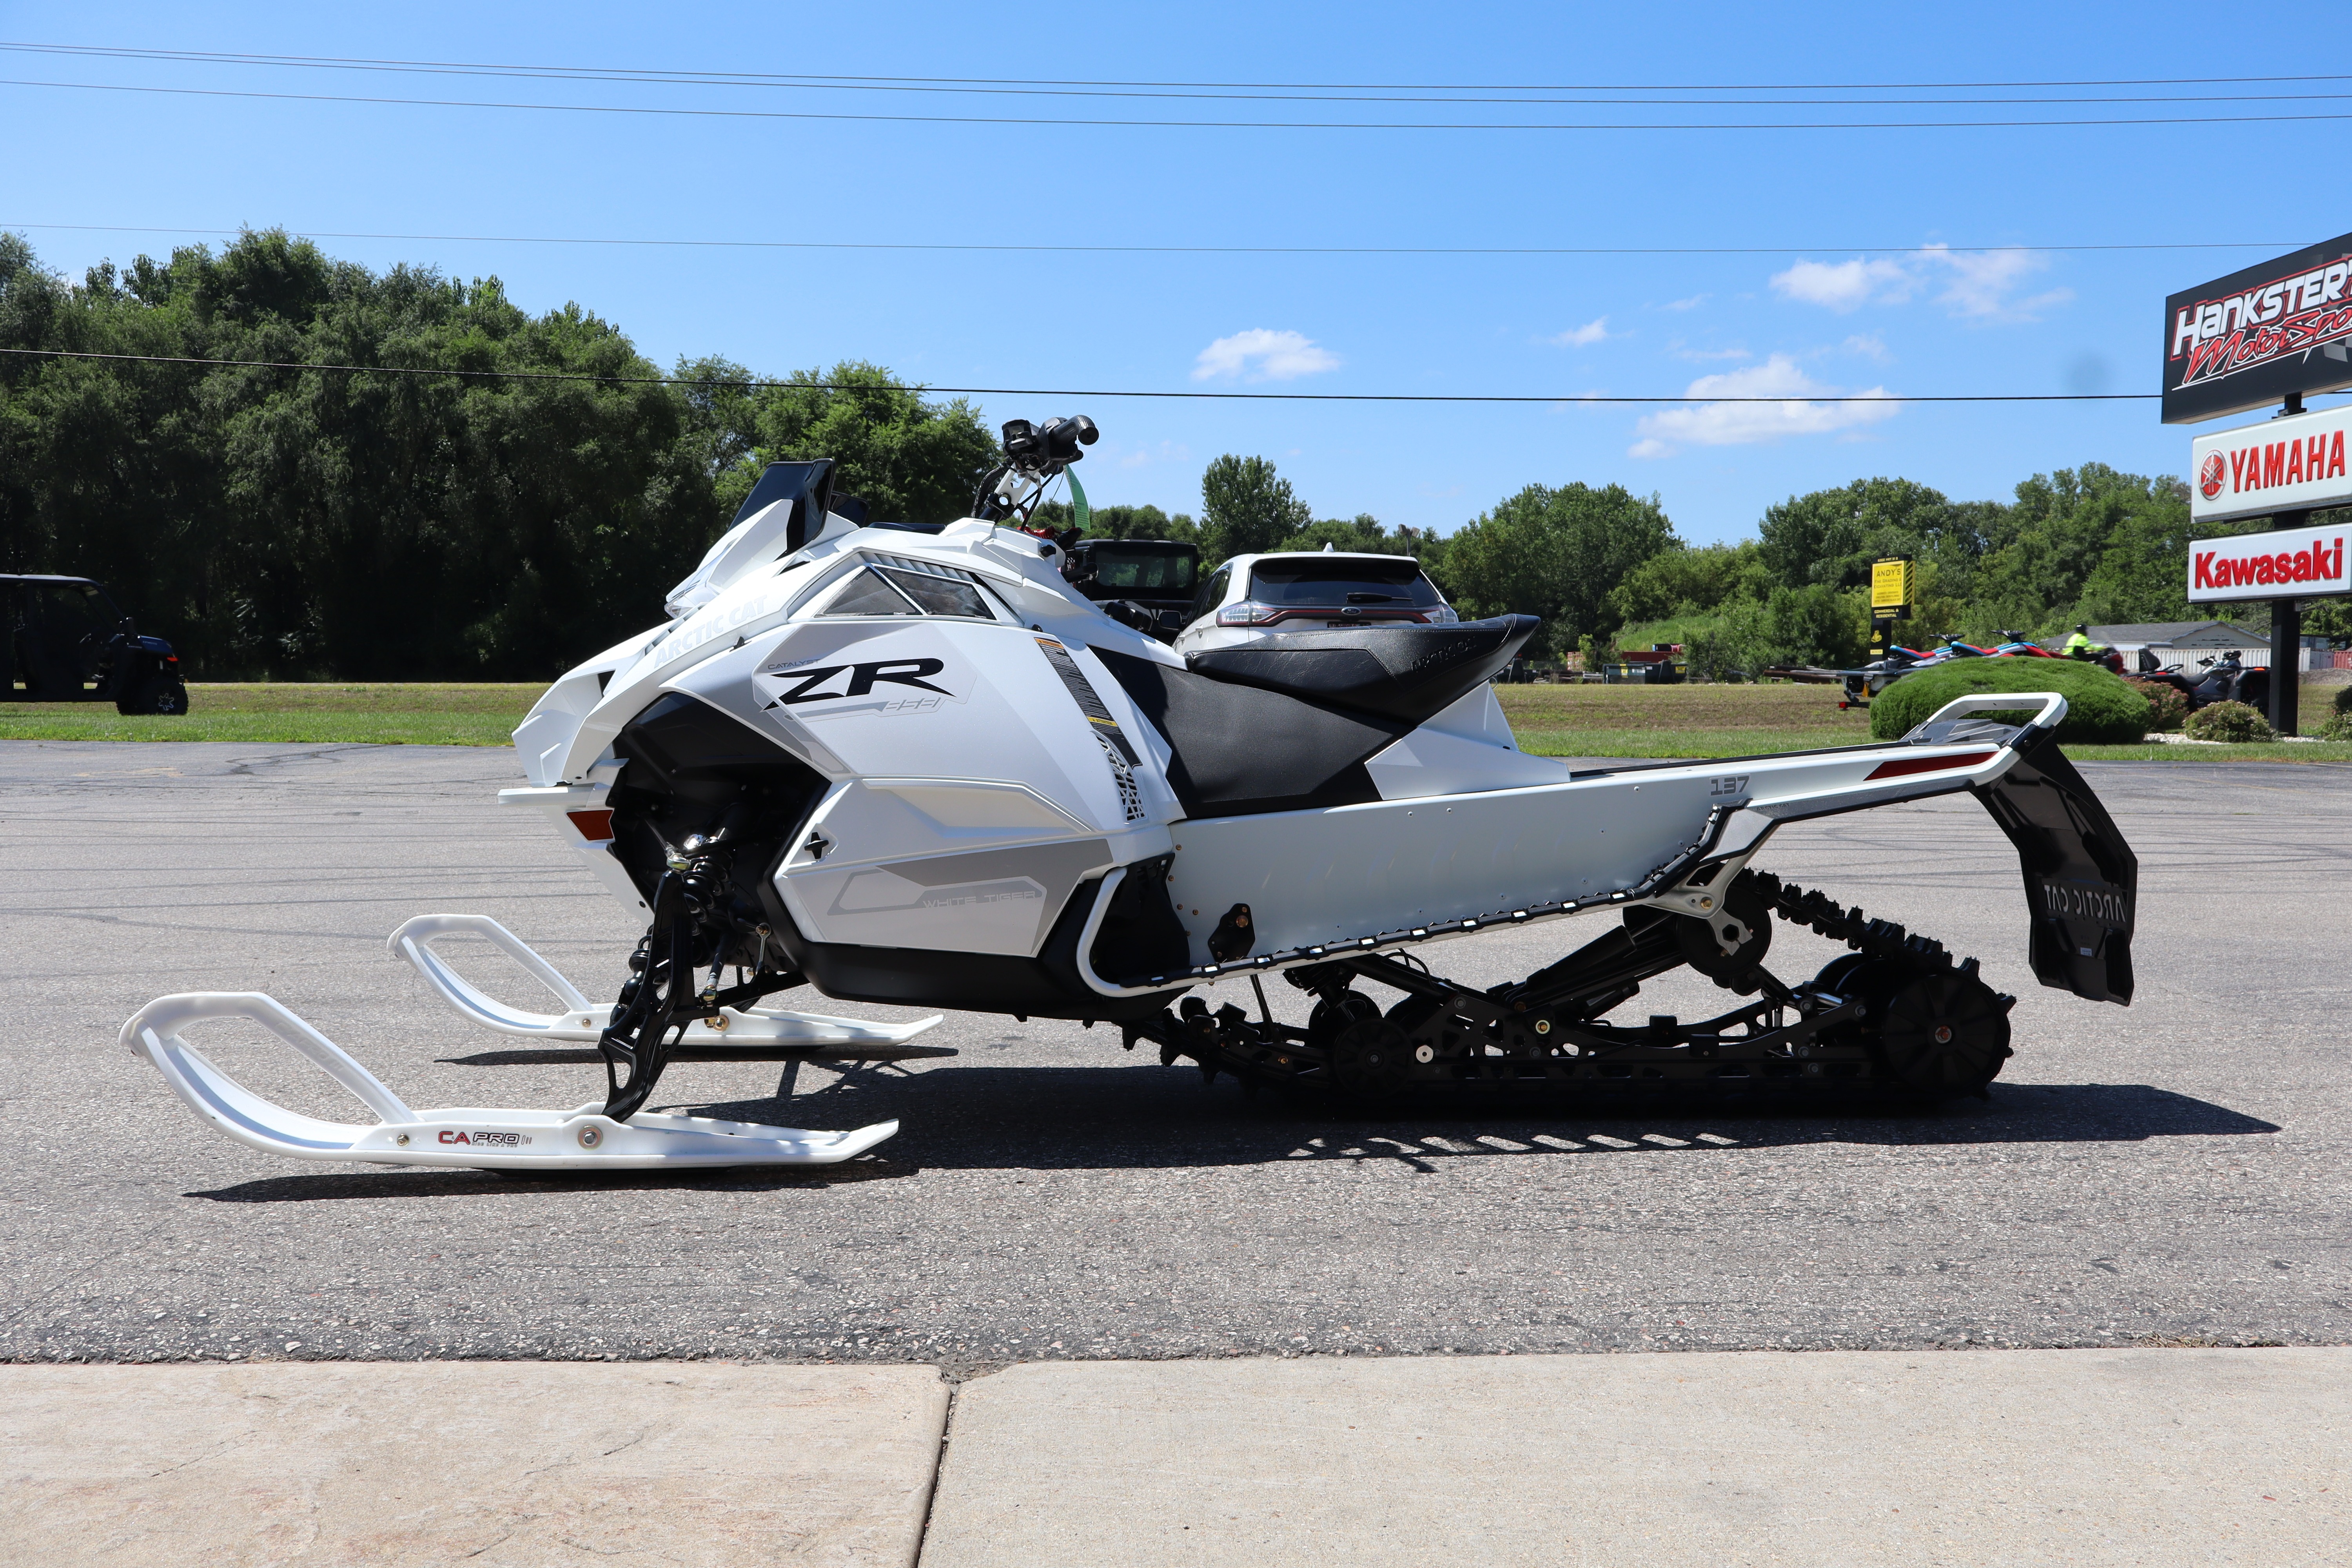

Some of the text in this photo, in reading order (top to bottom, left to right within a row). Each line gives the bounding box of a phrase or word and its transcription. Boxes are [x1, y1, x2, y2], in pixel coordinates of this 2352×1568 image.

[2230, 430, 2346, 493] YAMAHA
[1876, 567, 1901, 577] ANDY'S
[2194, 537, 2343, 589] Kawasaki
[654, 594, 767, 669] ARCTIC CAT
[768, 659, 820, 670] CATALYST
[760, 657, 957, 713] ZR
[1710, 775, 1750, 796] 137
[923, 891, 1036, 909] WHITE TIGER
[473, 1132, 520, 1144] PRO
